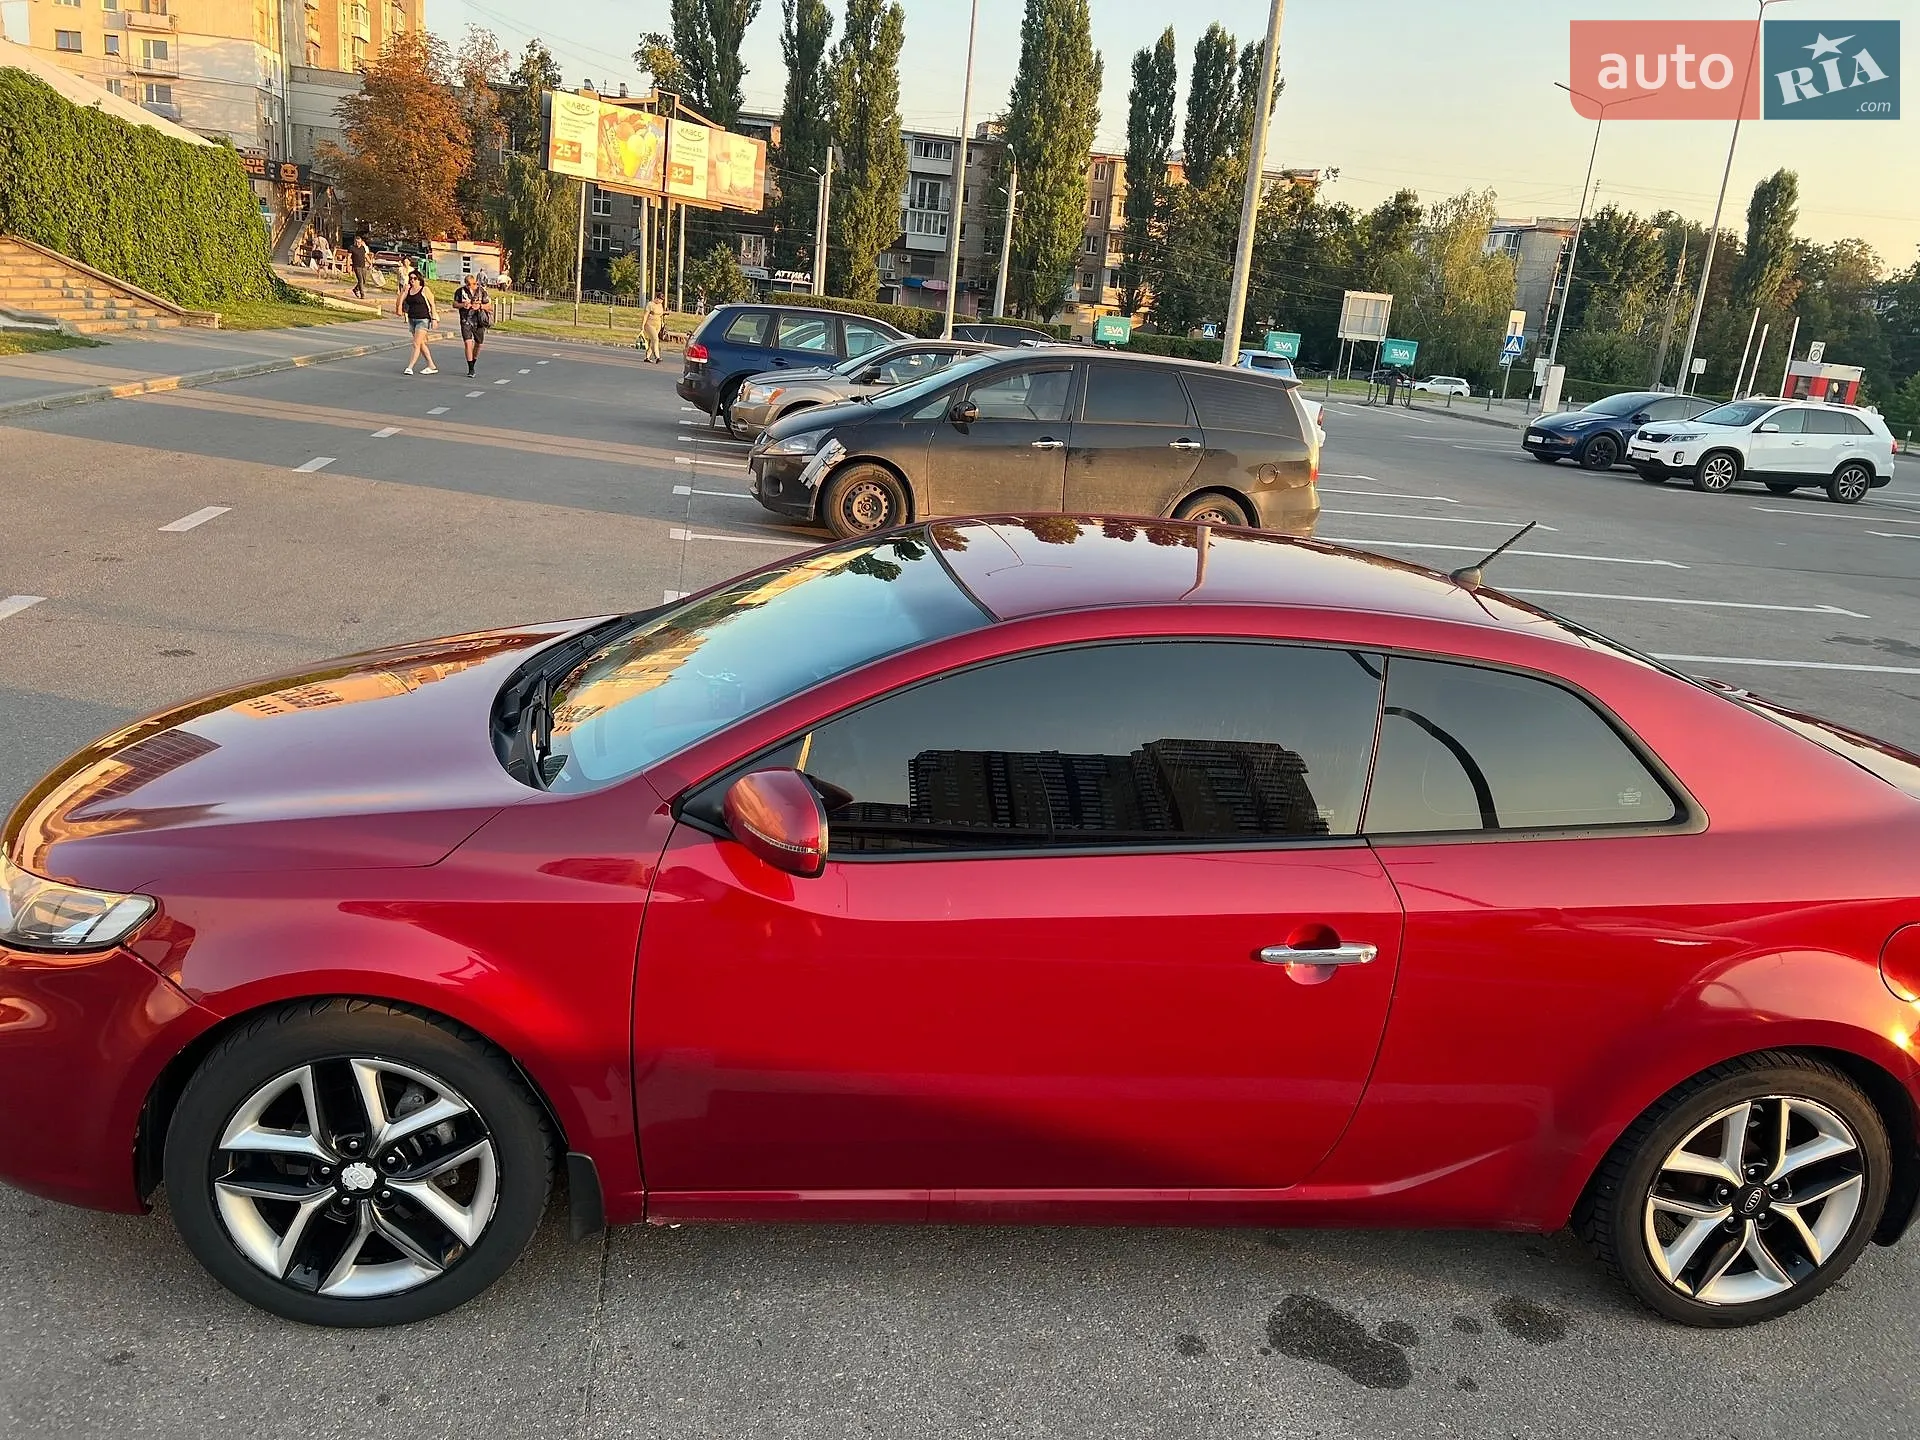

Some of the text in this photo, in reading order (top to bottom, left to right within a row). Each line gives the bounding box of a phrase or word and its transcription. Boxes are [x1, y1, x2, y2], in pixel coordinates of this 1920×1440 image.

[775, 269, 811, 282] АТТИКА
[1104, 325, 1124, 335] EVA
[1274, 341, 1293, 351] EVA
[1391, 348, 1410, 358] EVA
